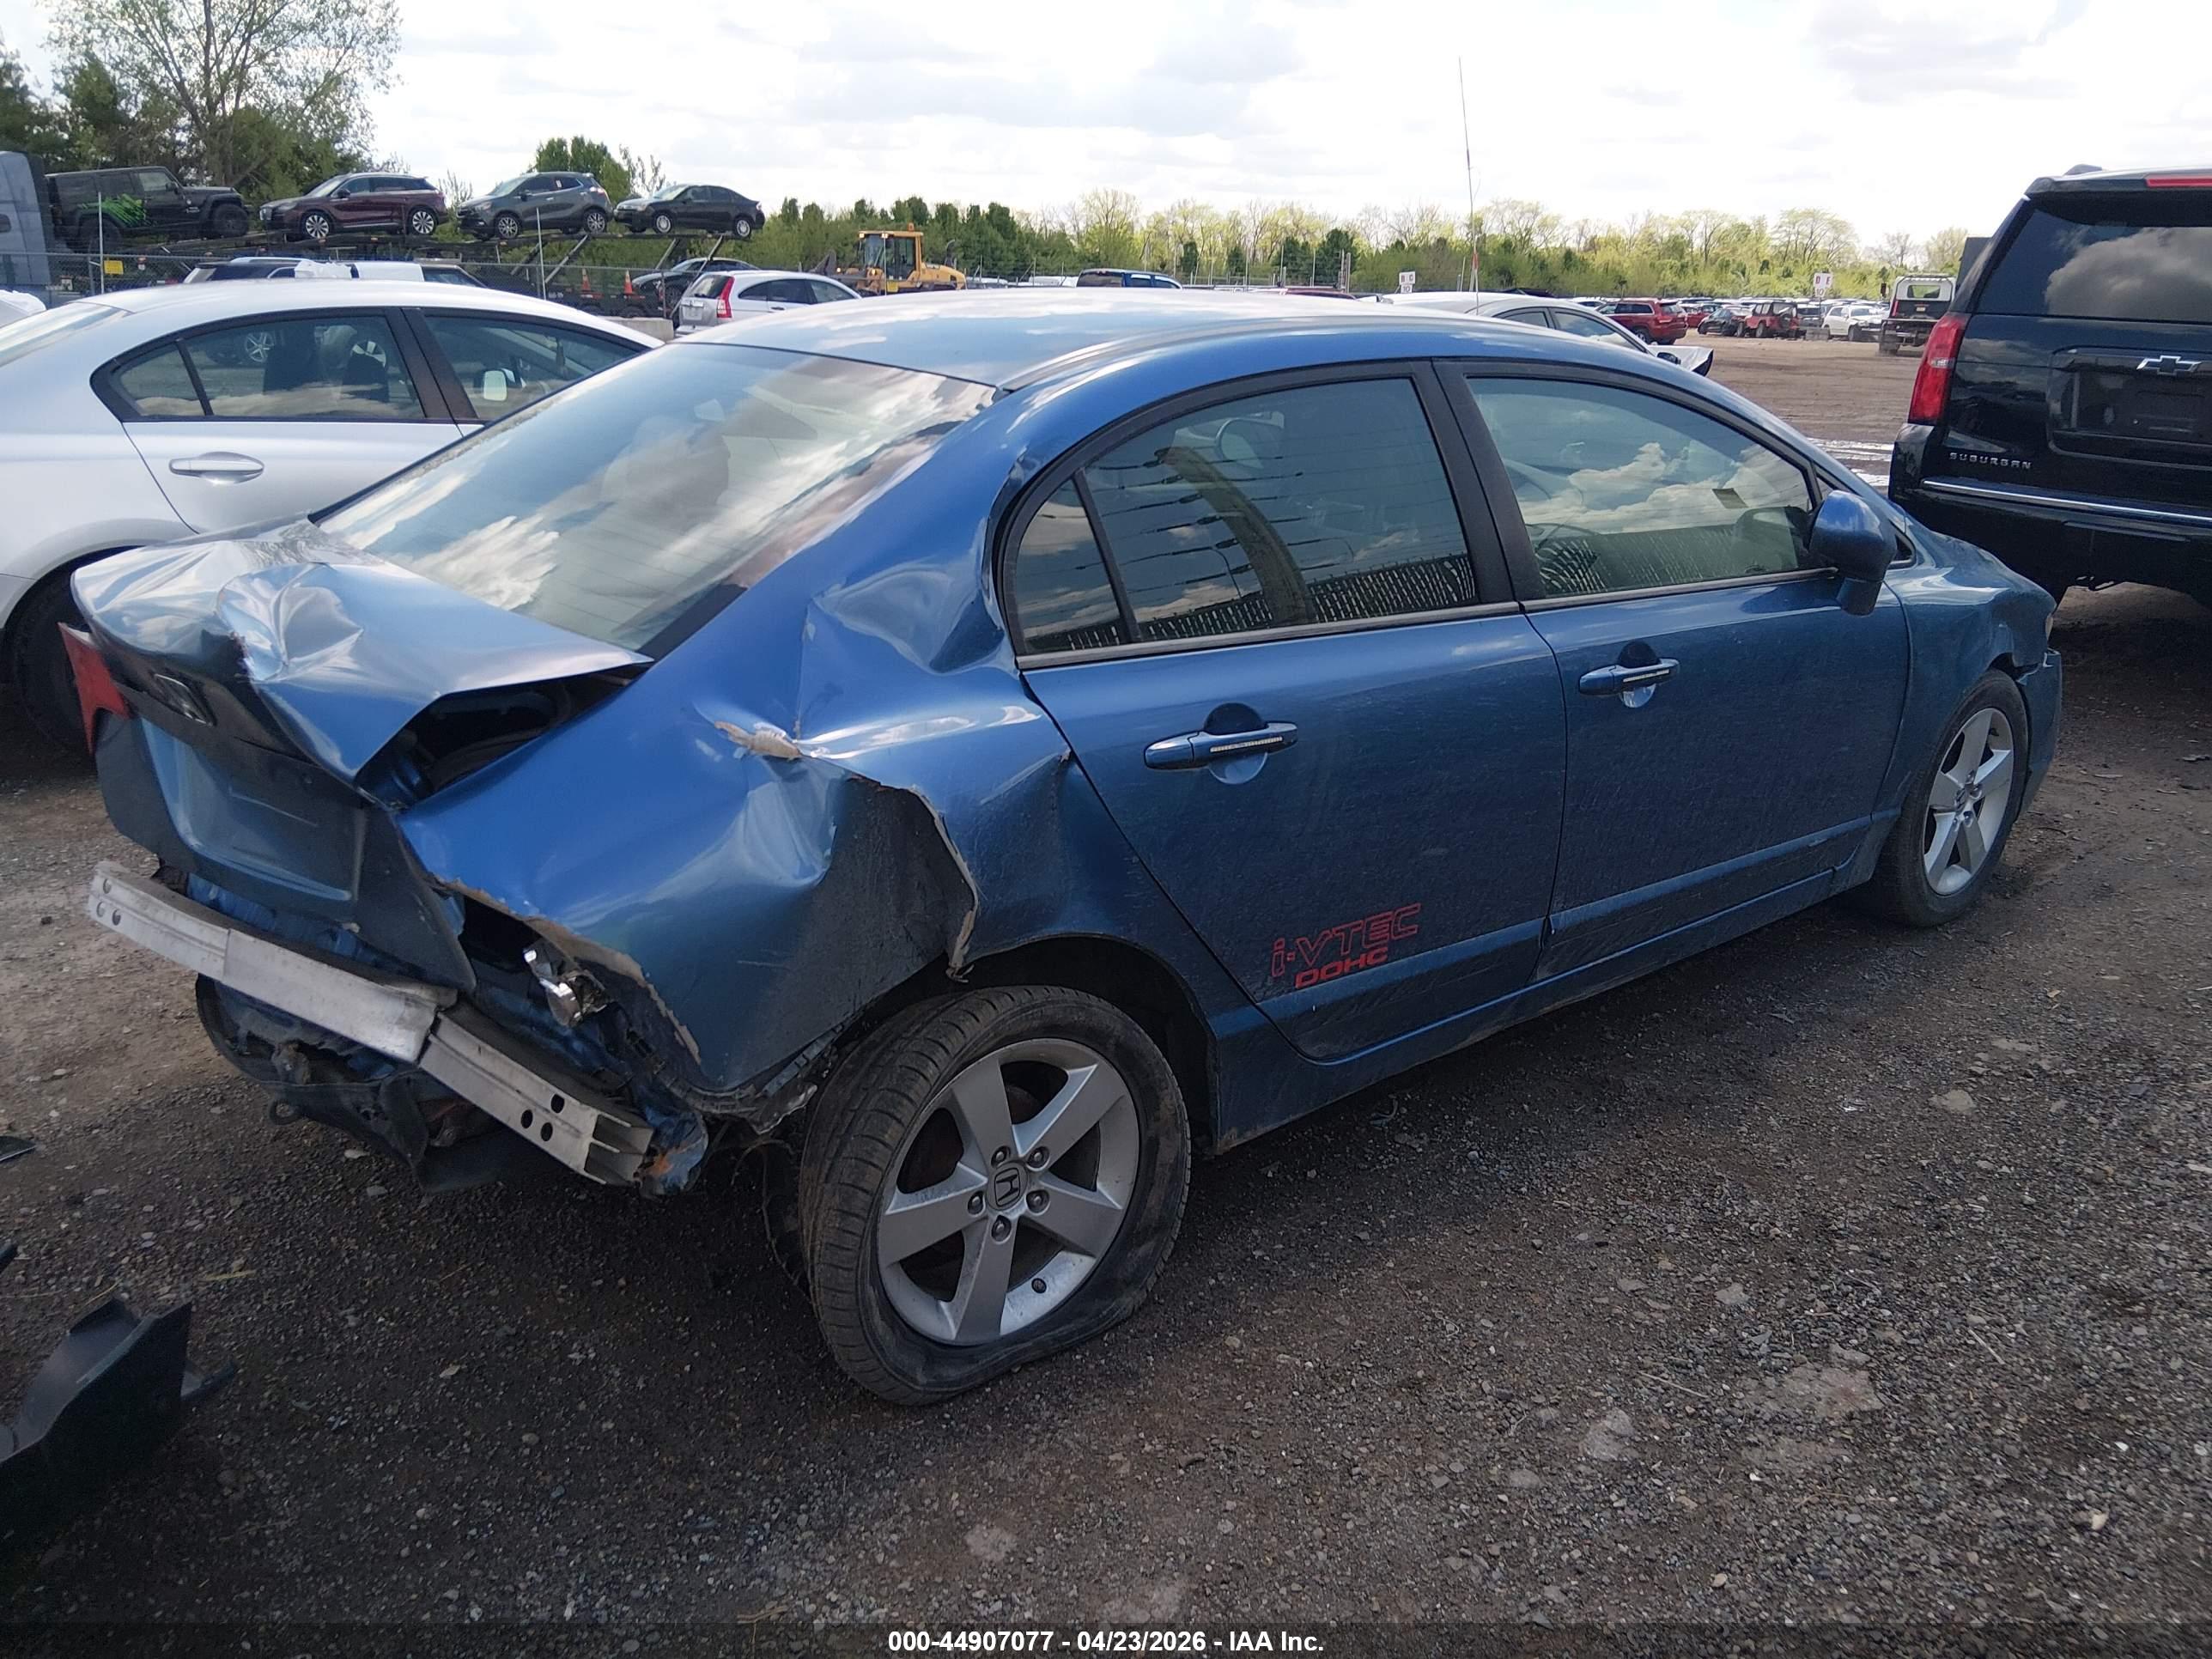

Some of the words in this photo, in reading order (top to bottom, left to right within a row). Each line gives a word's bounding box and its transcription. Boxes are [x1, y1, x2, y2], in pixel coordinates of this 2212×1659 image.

[1949, 452, 2032, 470] SUBURBAN
[1271, 902, 1421, 977] i-VTEC
[1295, 946, 1389, 988] DOHC
